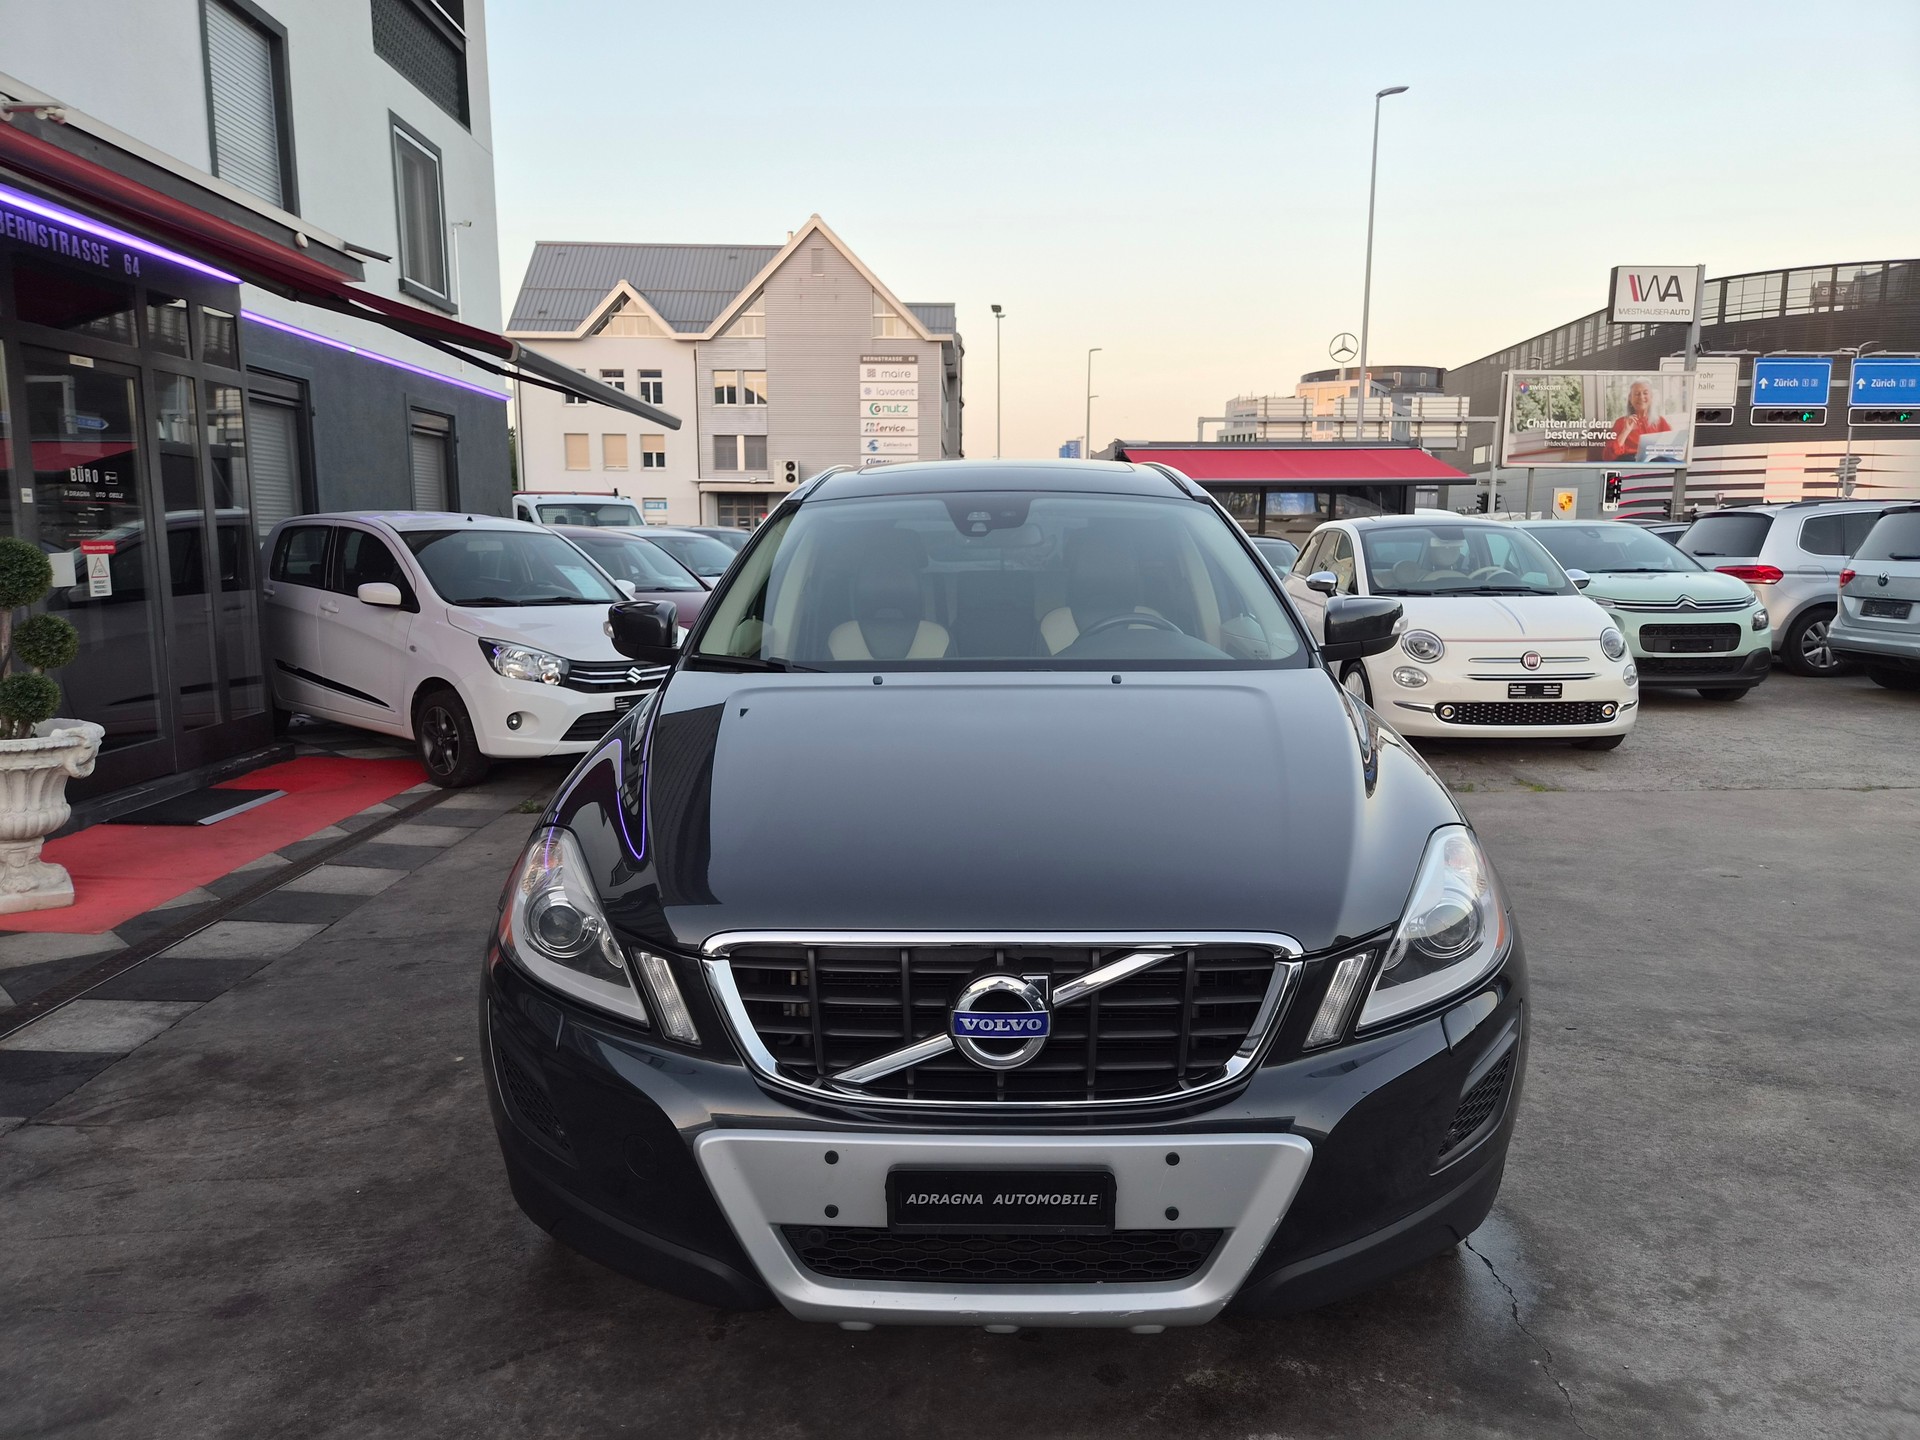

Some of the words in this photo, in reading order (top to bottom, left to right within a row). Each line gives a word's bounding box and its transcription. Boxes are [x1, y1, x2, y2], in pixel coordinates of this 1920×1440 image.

[123, 253, 141, 278] 64
[881, 369, 911, 378] maire
[1529, 383, 1561, 391] swisscom
[1773, 378, 1799, 387] Zürich
[1871, 378, 1896, 387] Zürich
[1526, 418, 1566, 429] Chatten
[1569, 418, 1586, 429] mit
[1588, 418, 1612, 429] dem
[1545, 429, 1579, 440] besten
[1581, 429, 1617, 440] Service
[69, 465, 99, 483] BÜRO
[959, 1018, 1042, 1031] VOLVO
[906, 1193, 984, 1205] ADRAGNA
[992, 1193, 1099, 1205] AUTOMOBILE
